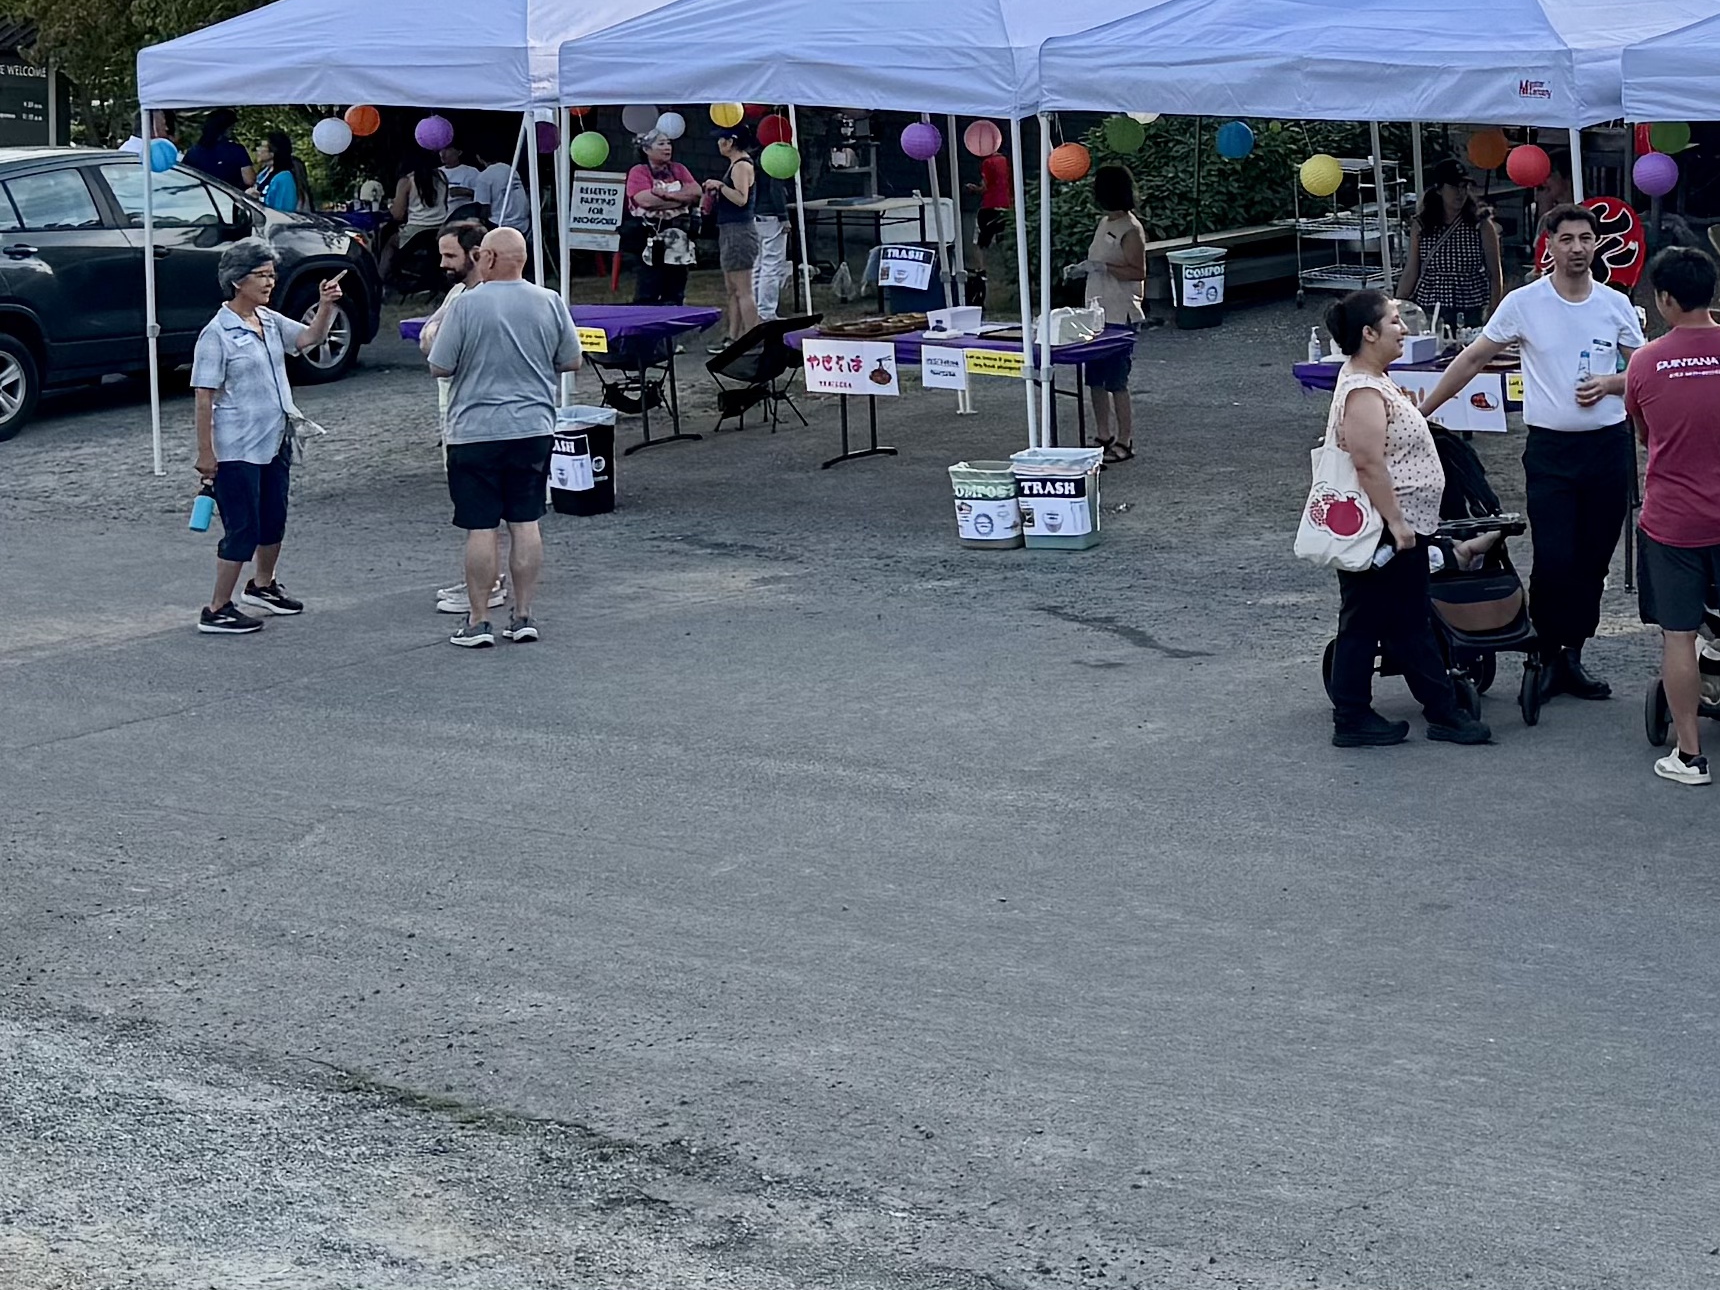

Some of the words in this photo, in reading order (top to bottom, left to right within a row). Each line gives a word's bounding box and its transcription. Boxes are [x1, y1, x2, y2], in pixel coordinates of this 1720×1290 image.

[7, 65, 46, 78] WELCOME
[579, 197, 616, 206] PARKING
[588, 207, 603, 215] FOR
[887, 249, 924, 260] TRASH
[1185, 265, 1226, 279] COMPOS
[1656, 356, 1719, 371] QUINTANA
[552, 439, 575, 454] ASH
[955, 485, 1015, 498] OMPOST
[1020, 481, 1076, 495] TRASH
